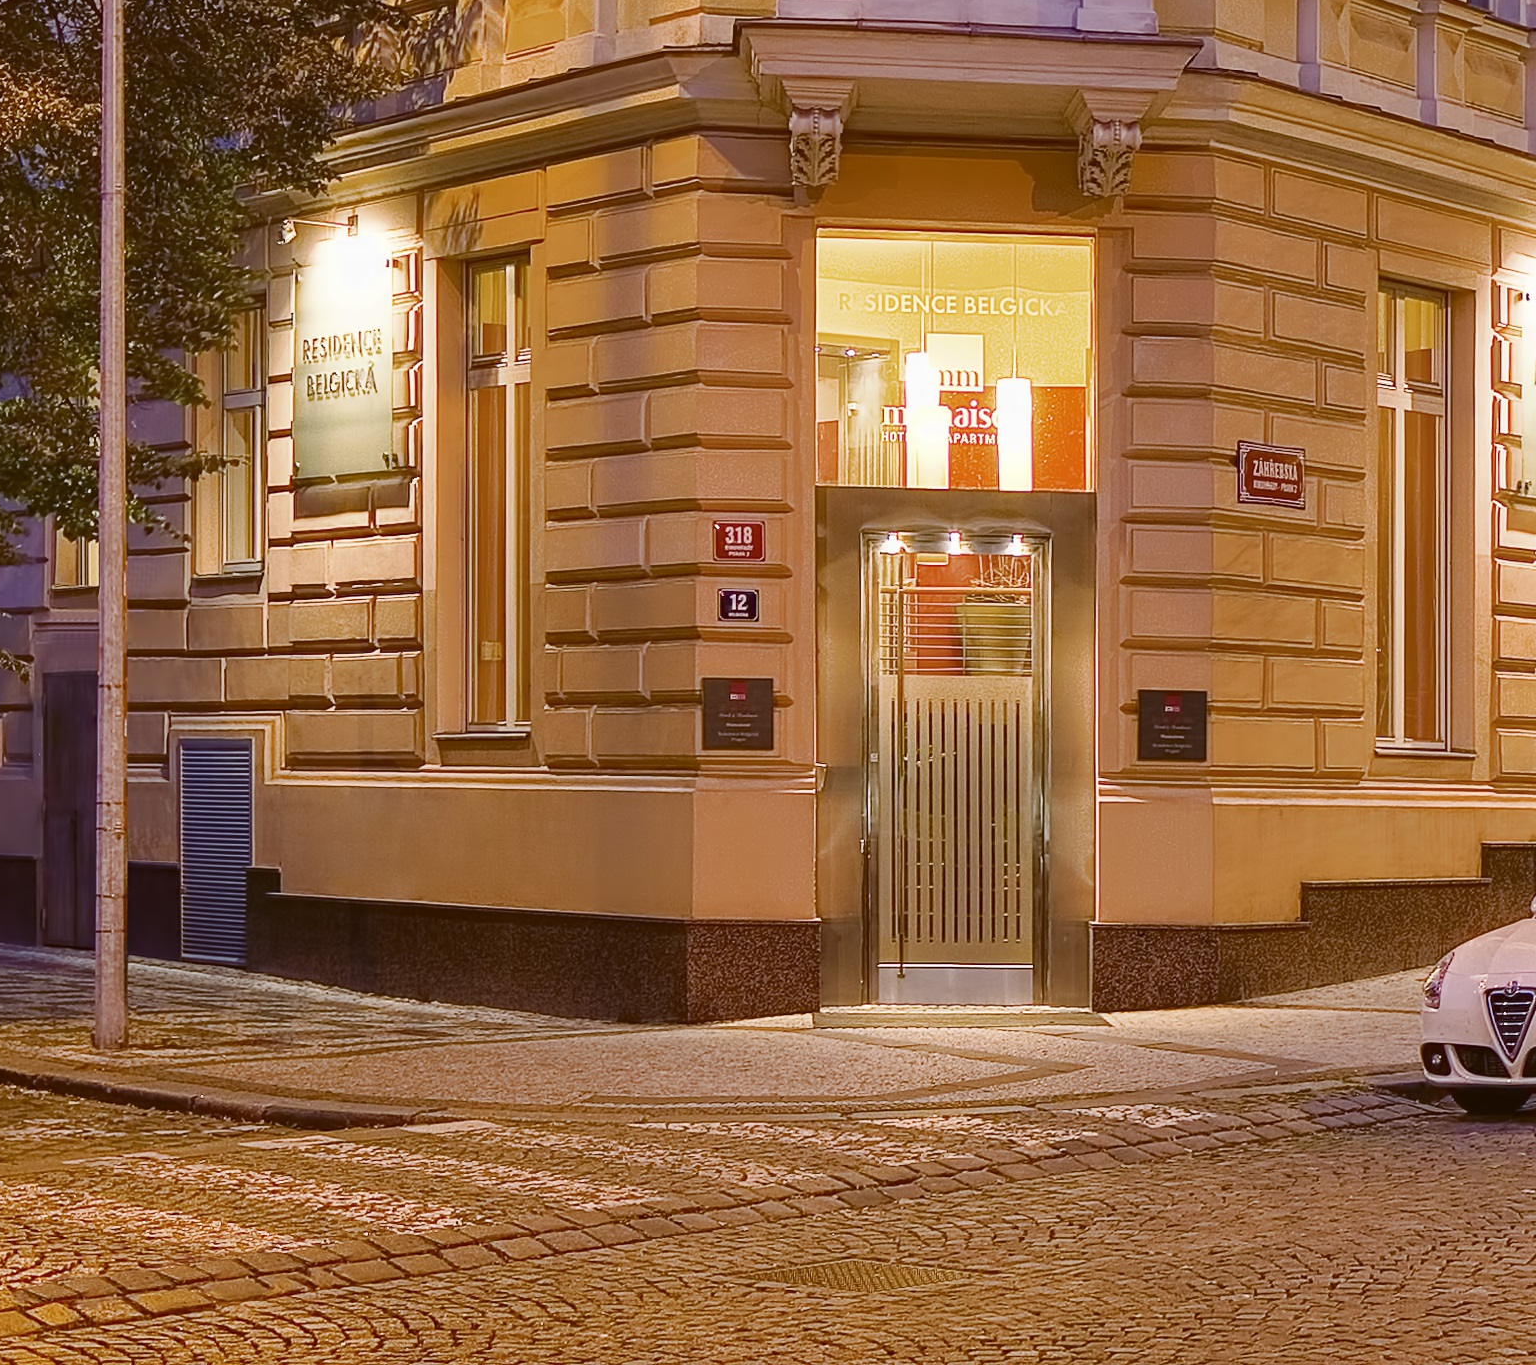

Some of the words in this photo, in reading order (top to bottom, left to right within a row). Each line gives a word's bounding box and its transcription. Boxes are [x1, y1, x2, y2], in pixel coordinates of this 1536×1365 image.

[303, 328, 382, 362] RESIDENCE
[307, 361, 378, 398] BELGICKÁ
[725, 526, 752, 544] 318
[729, 594, 748, 610] 12
